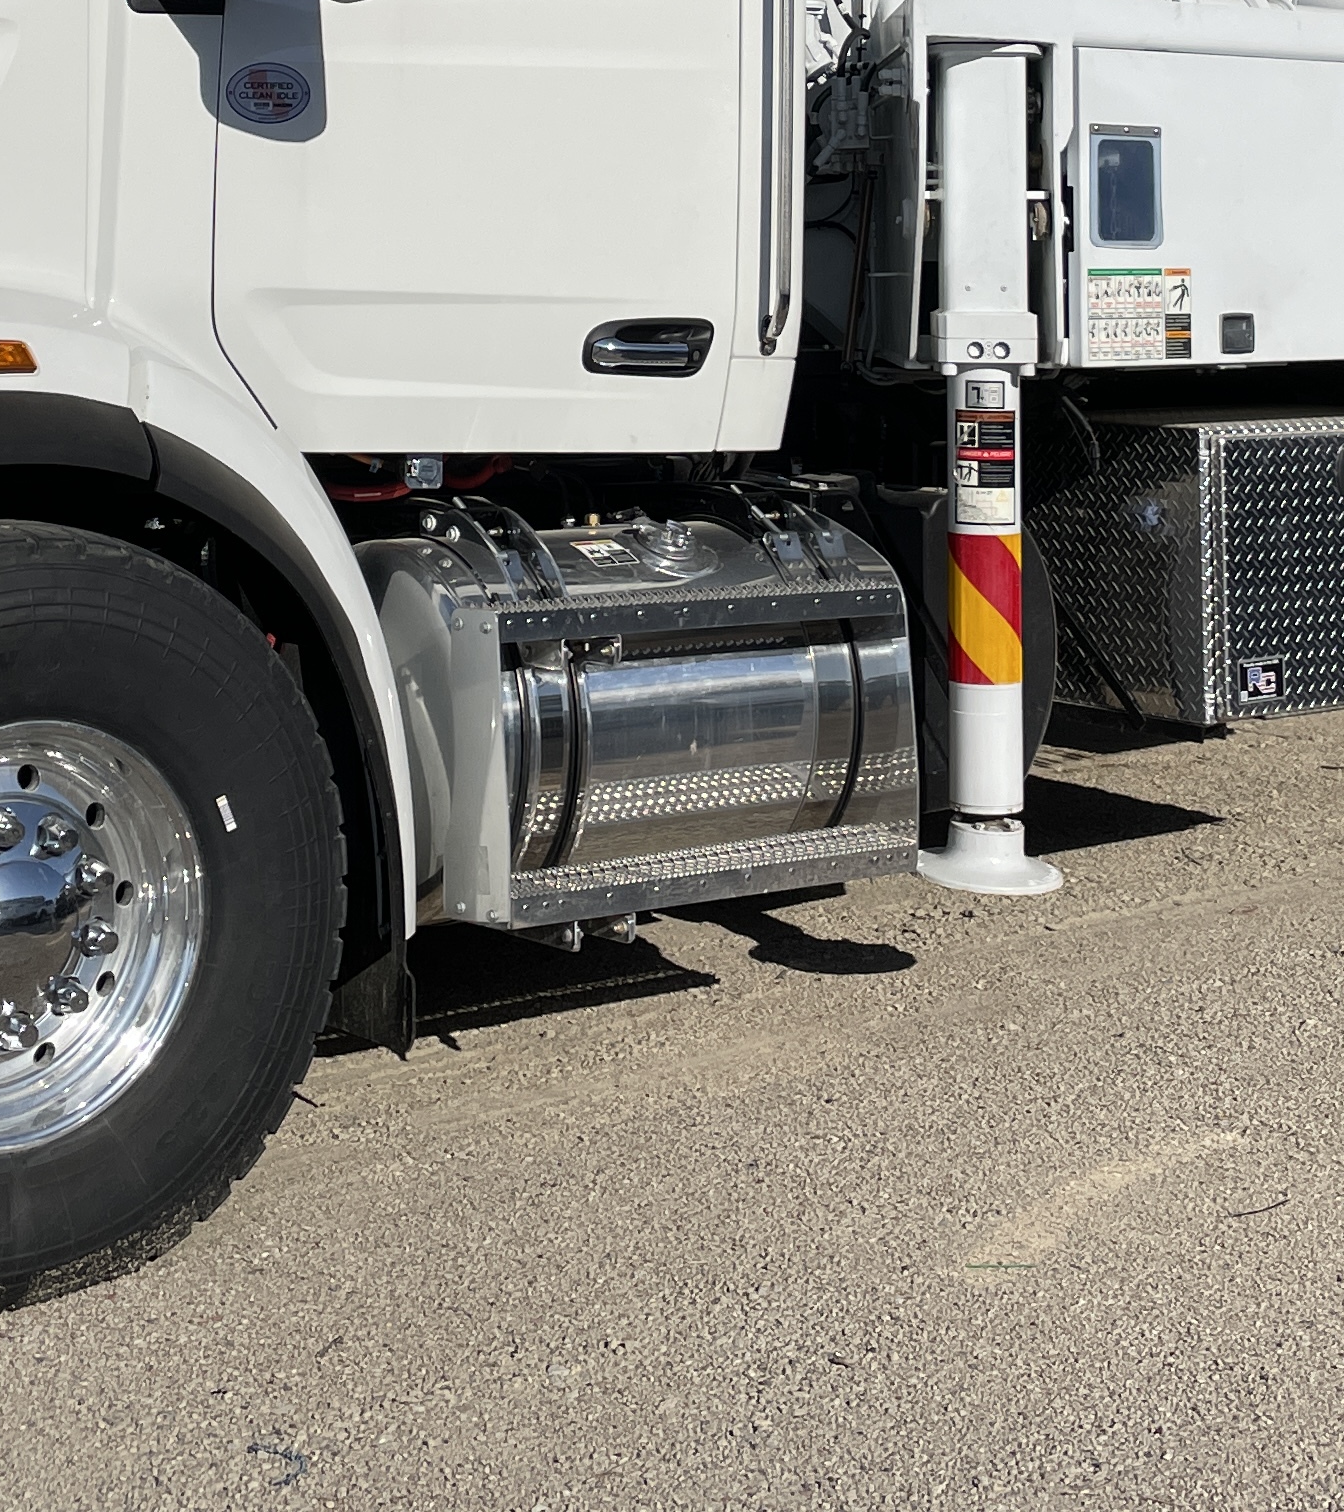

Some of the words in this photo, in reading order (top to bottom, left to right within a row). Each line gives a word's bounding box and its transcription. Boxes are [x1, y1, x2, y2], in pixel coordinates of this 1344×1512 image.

[243, 81, 294, 90] CERTIFIED
[238, 91, 273, 100] CLEAN
[276, 92, 299, 100] IDLE
